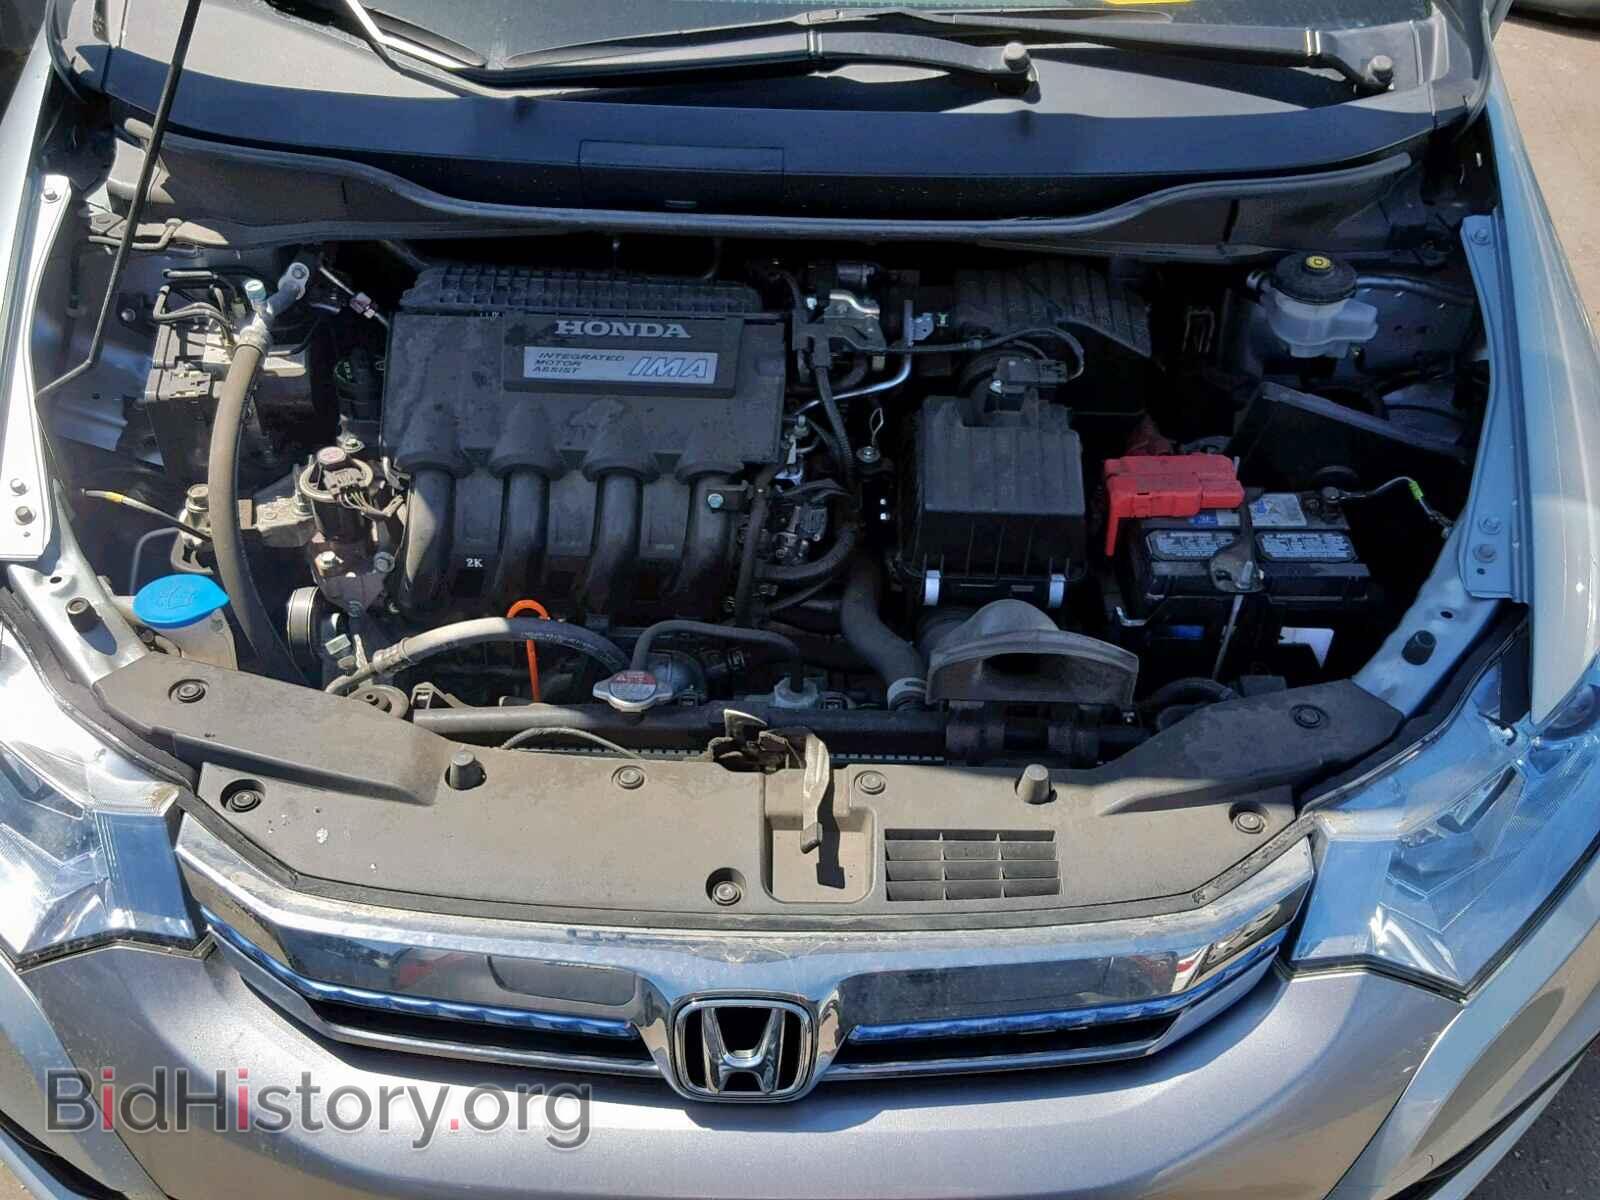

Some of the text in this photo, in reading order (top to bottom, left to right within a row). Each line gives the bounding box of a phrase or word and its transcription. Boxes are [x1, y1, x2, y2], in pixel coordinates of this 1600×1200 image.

[554, 319, 692, 339] HONDA
[538, 352, 625, 361] INTEGRATED
[534, 359, 582, 367] MOTOR
[628, 356, 709, 379] IMA
[532, 366, 580, 374] ASSIST
[466, 558, 484, 568] 2K
